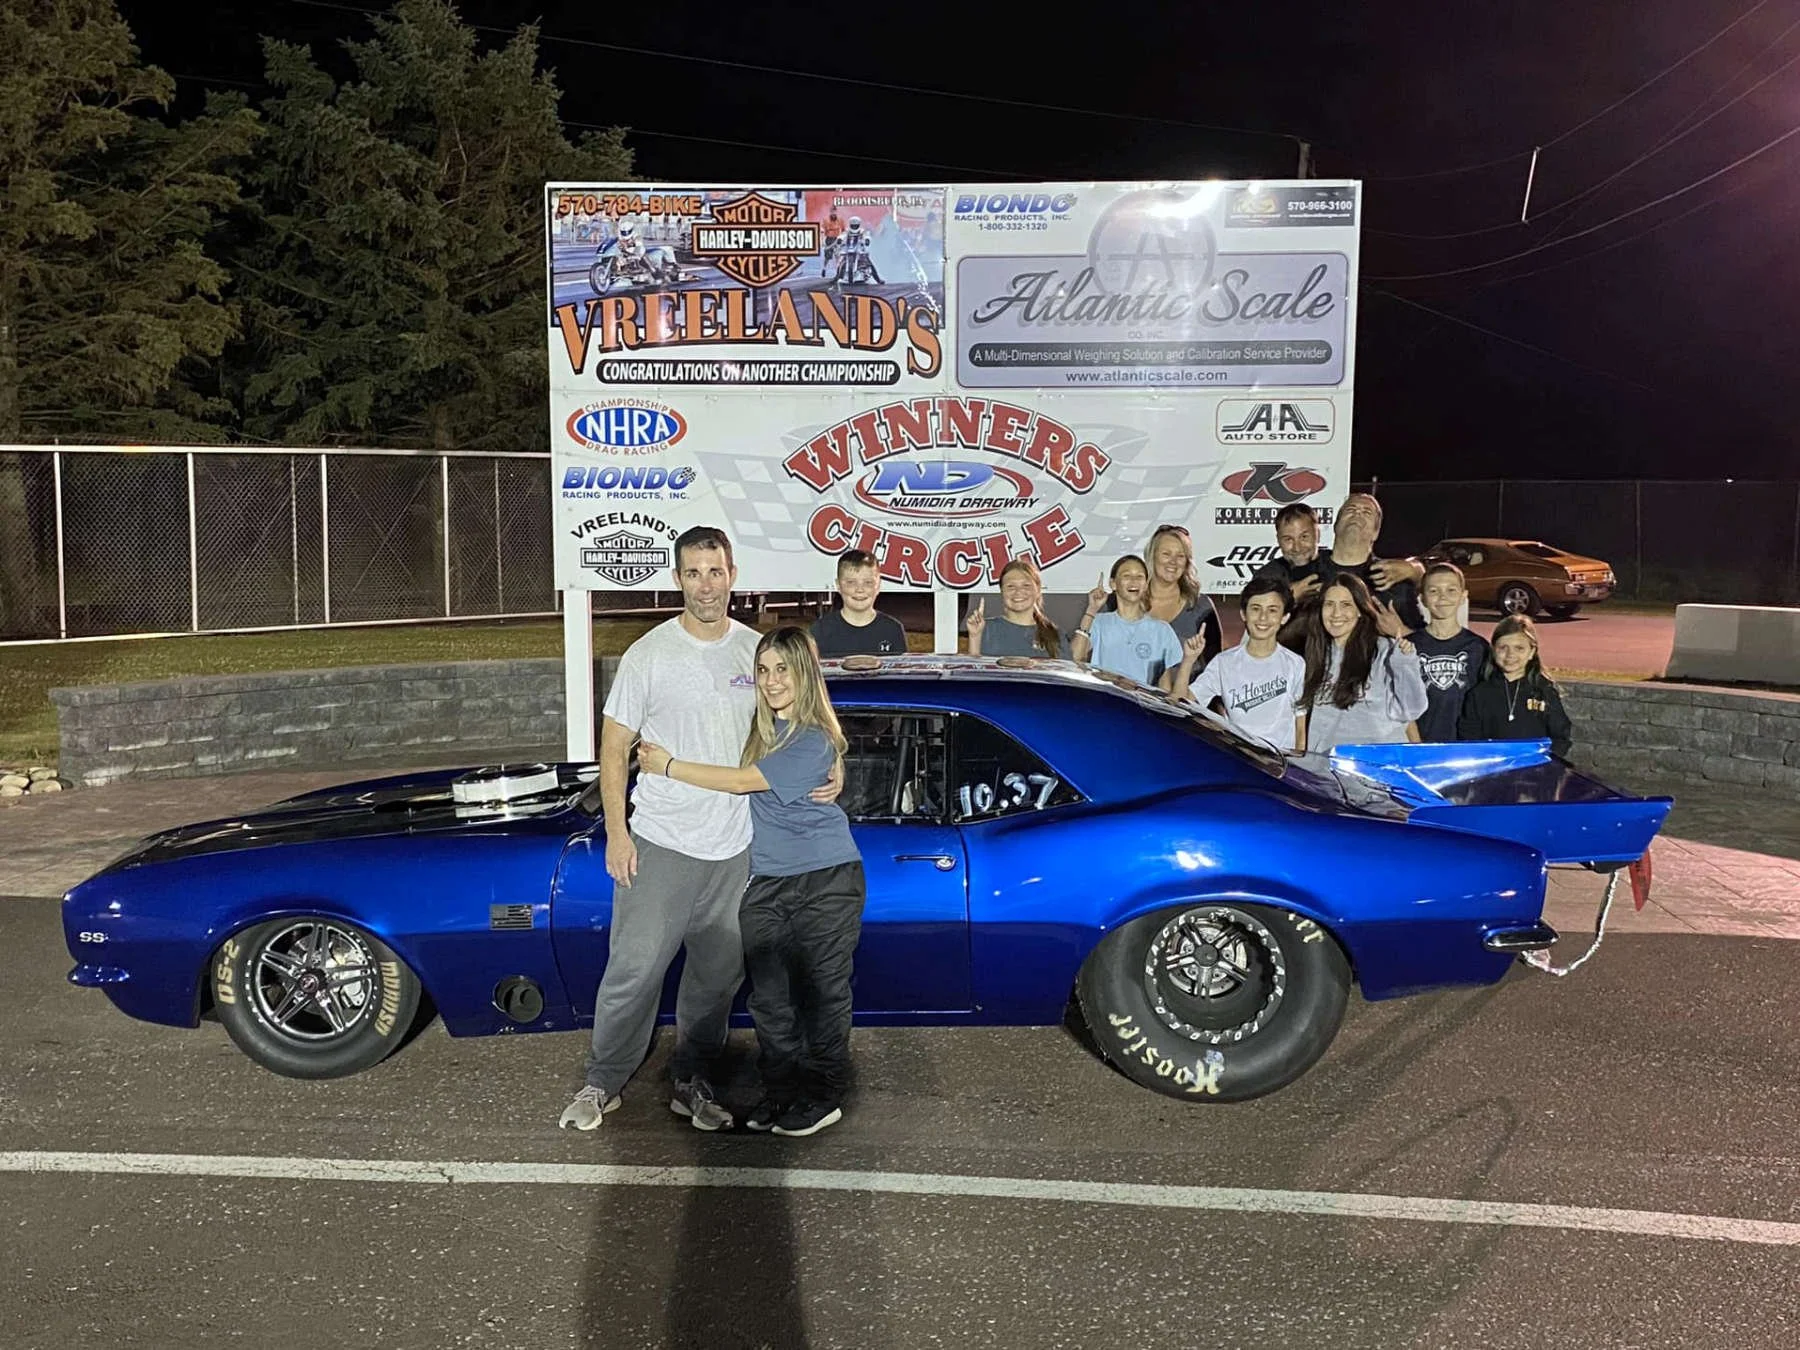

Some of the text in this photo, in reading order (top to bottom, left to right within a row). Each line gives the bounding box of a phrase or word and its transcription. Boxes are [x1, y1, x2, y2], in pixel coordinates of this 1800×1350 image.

[558, 194, 701, 216] 570-784-BIKE
[724, 200, 786, 223] MOTOR
[954, 193, 1077, 213] BIONDO
[994, 214, 1047, 222] PRODUCTS,
[979, 223, 1048, 231] 1-800-332-1320
[699, 230, 814, 250] HARLEY-DAVIDSON
[726, 256, 789, 282] CYCLES
[973, 263, 1336, 323] Atlantic Scale
[555, 287, 943, 378] VREELAND'S
[973, 347, 1328, 364] A Multi-Dimensional Weighing Solution and Calibration Service Provider
[602, 362, 896, 382] CONGRATULATIONS ON ANOTHER CHAMPIONSHIP
[1065, 370, 1228, 383] www.atlanticscale.com
[585, 398, 669, 413] CHAMPIONSHIP
[586, 409, 671, 445] NHRA
[782, 396, 1112, 495] WINNERS
[1224, 433, 1317, 441] AUTO STORE
[586, 441, 668, 456] DRAG RACING
[562, 467, 697, 490] BIONDO
[867, 461, 995, 496] ND
[607, 492, 664, 500] PRODUCTS,
[669, 492, 690, 500] INC.
[889, 497, 1039, 508] NUMIDIA DRAGWAY
[1215, 507, 1262, 518] KOREK
[571, 512, 679, 541] VREELAND'S
[887, 521, 1006, 529] www.numidiadragway.com
[603, 537, 646, 549] MOTOR
[585, 551, 665, 564] HARLEY-DAVIDSON
[603, 567, 648, 581] CYCLES
[958, 771, 1058, 817] 10.37
[79, 931, 105, 943] SS
